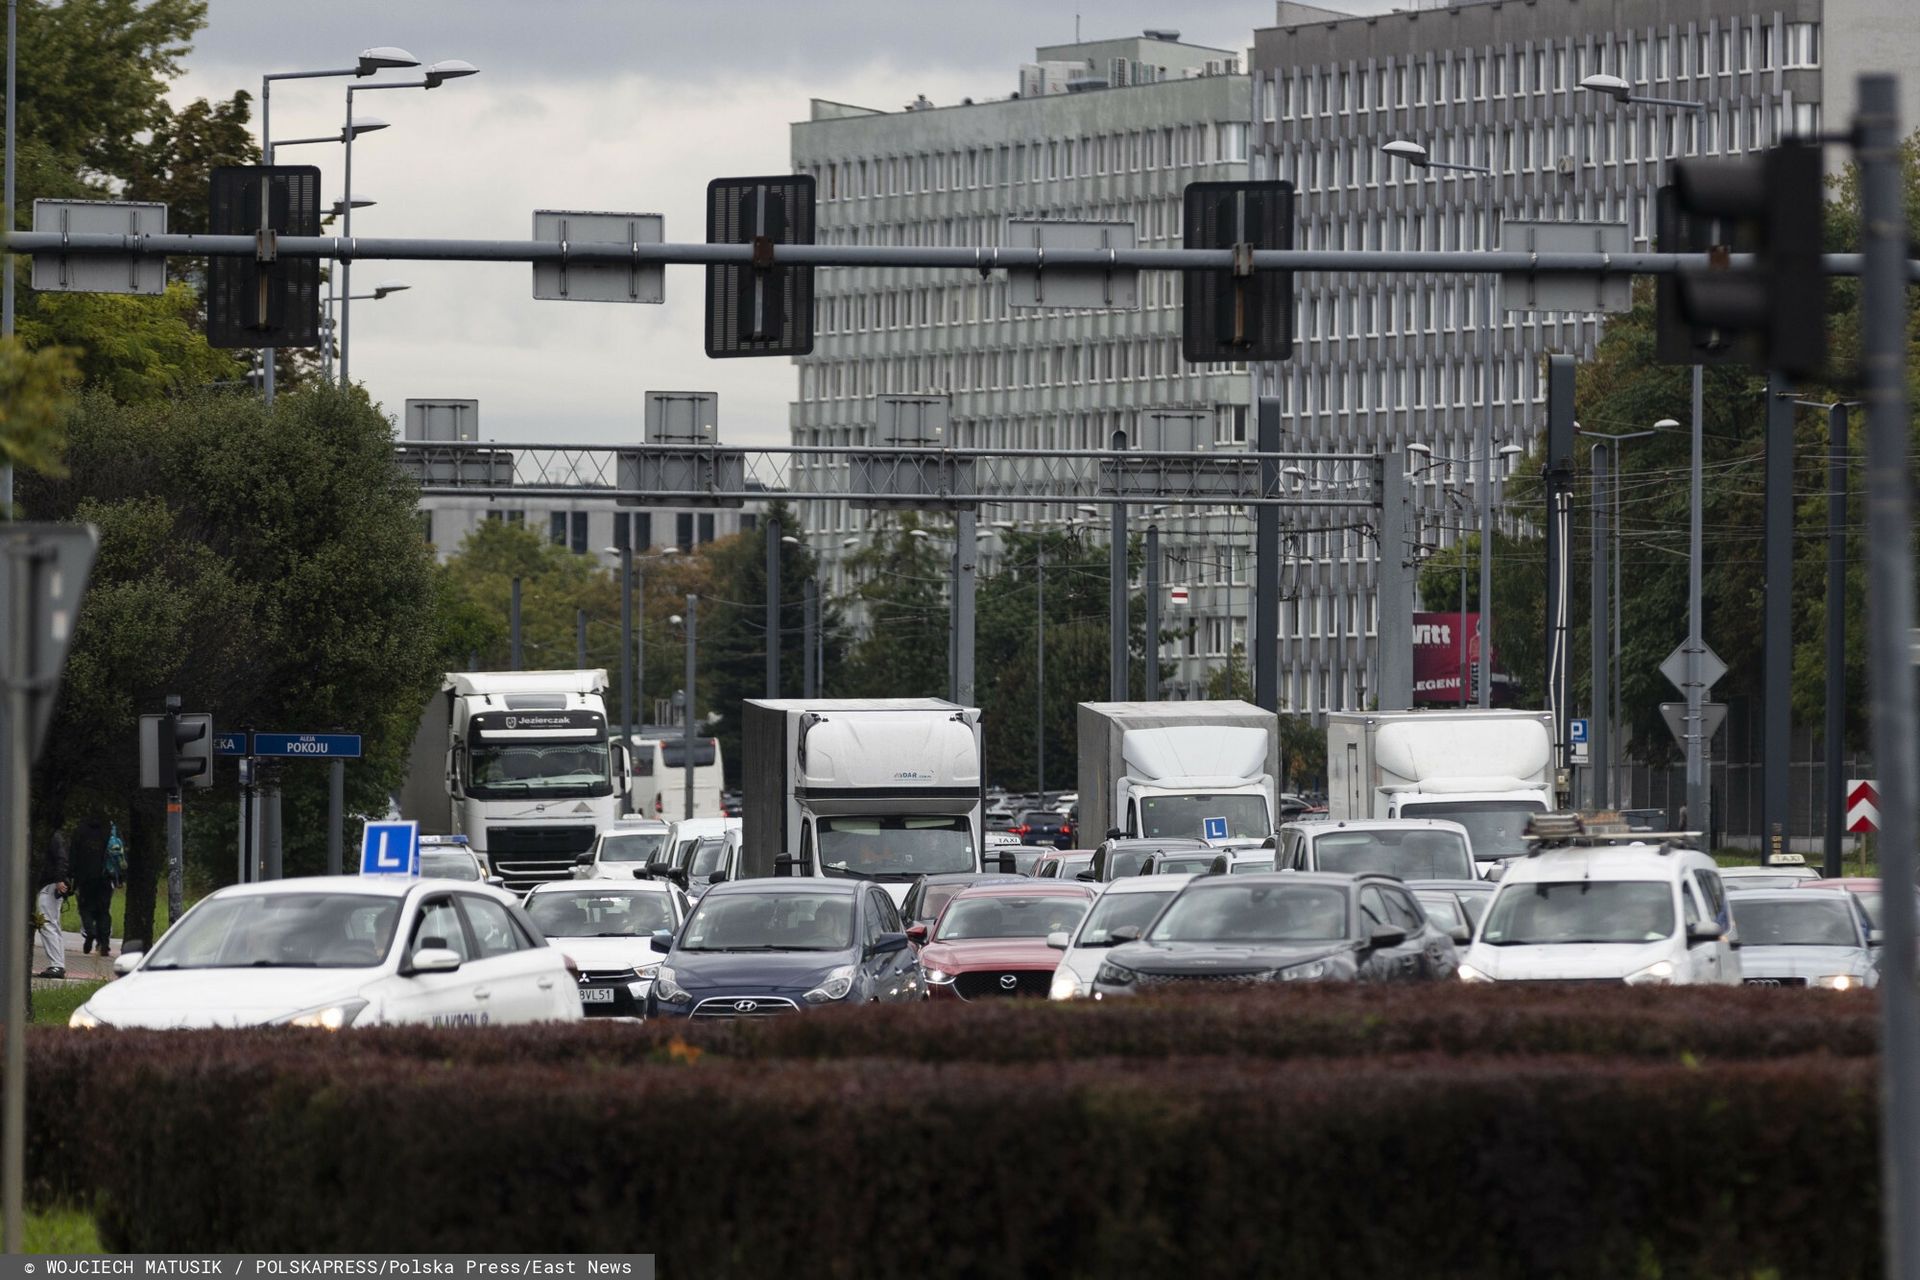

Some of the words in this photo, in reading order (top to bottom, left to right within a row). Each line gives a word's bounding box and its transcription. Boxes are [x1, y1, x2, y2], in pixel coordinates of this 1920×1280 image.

[1570, 721, 1583, 741] P
[287, 742, 328, 753] POKOJU
[1211, 821, 1223, 836] L
[378, 831, 400, 867] L
